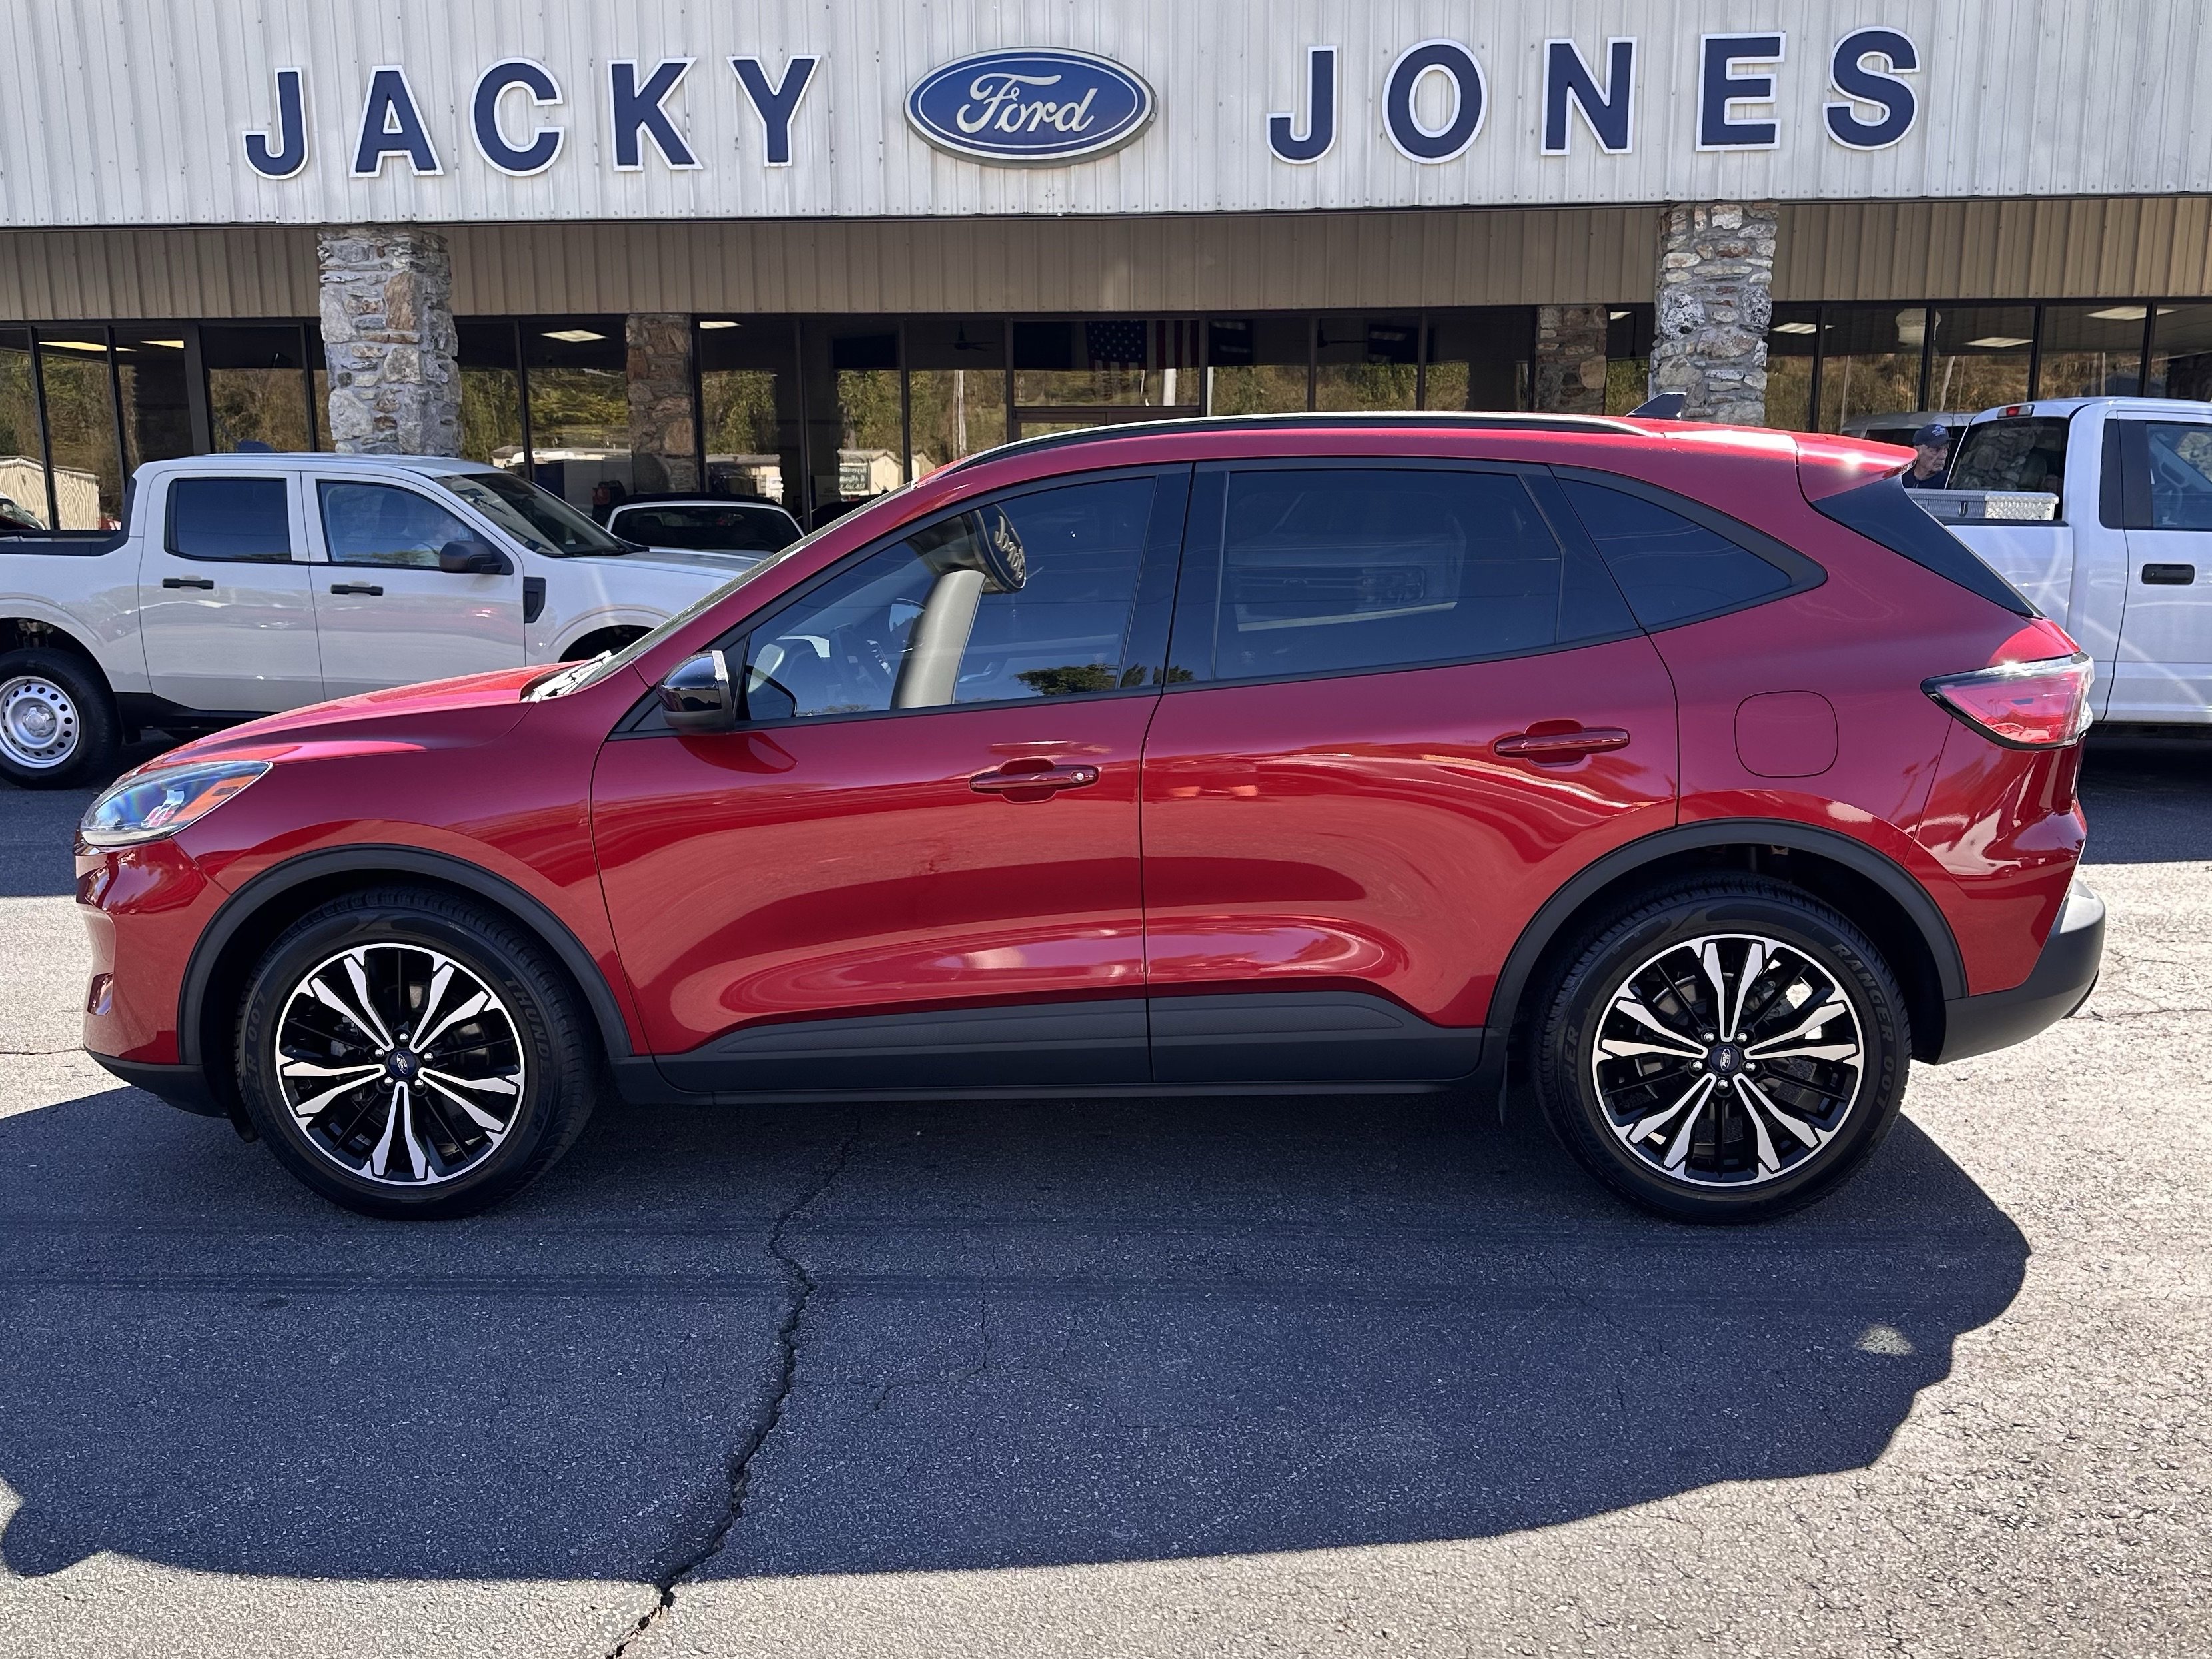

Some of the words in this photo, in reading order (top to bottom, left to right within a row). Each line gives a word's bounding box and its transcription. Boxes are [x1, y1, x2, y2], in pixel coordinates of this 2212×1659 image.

[242, 55, 821, 180] JACKY
[956, 72, 1099, 133] Ford
[1265, 25, 1920, 165] JONES
[247, 990, 265, 1043] 007
[1832, 943, 1894, 1043] RANGER
[1876, 1055, 1895, 1109] 007
